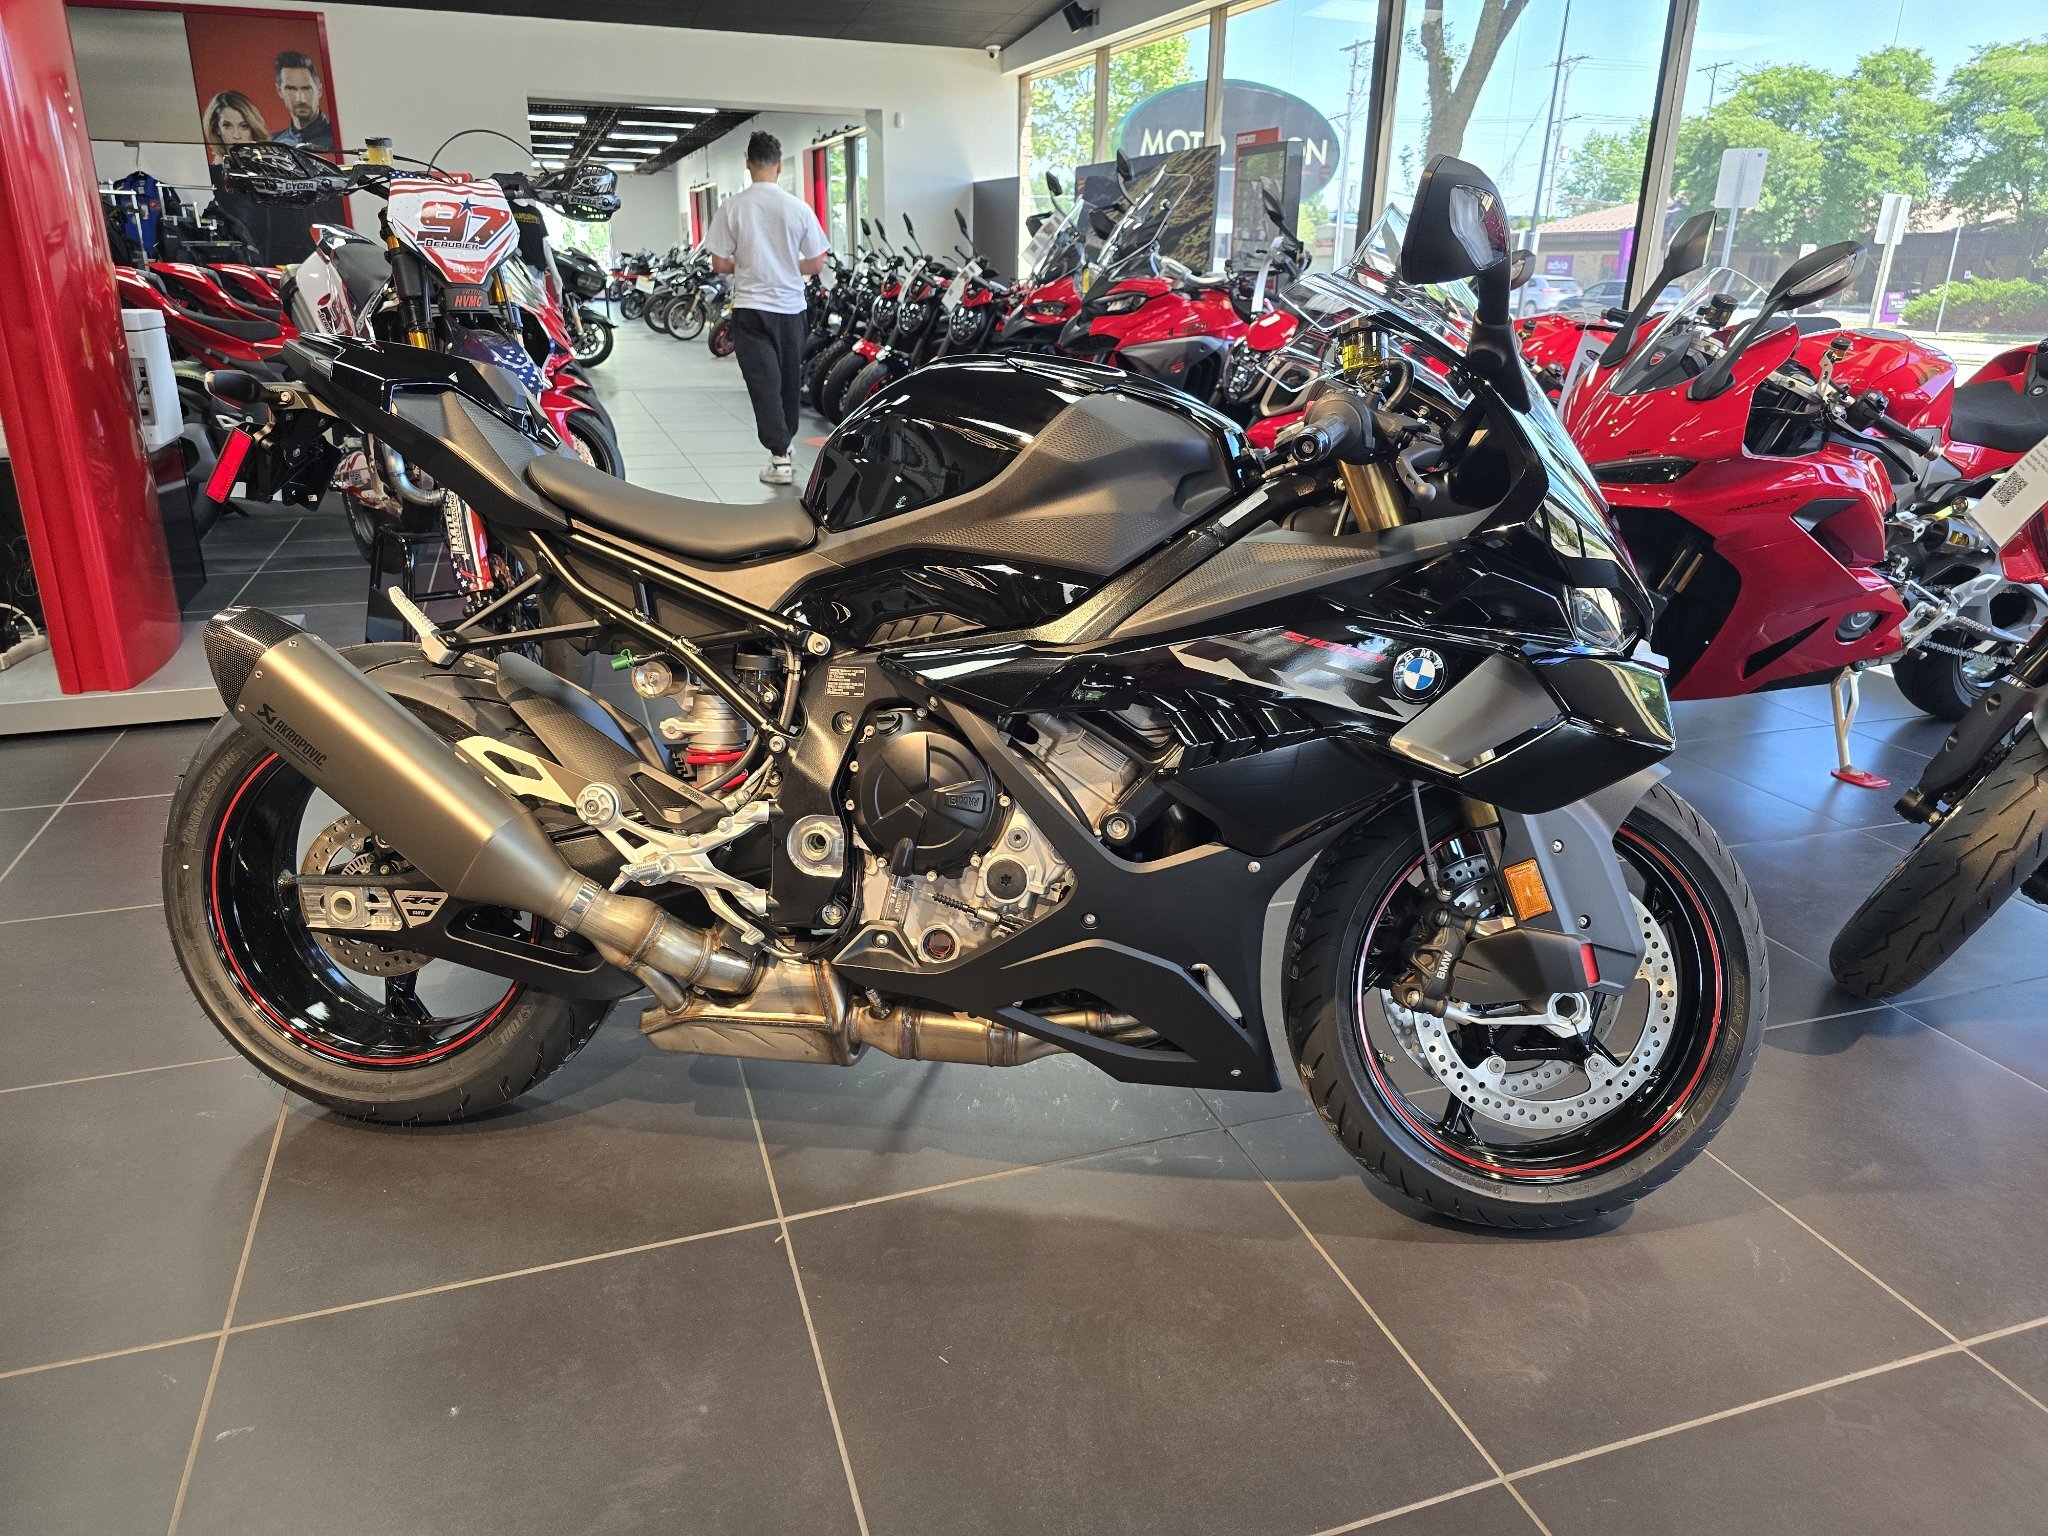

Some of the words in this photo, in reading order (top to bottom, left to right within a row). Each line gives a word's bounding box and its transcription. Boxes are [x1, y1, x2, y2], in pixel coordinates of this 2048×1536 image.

[285, 182, 314, 190] CYCRA
[416, 201, 511, 247] 97
[454, 295, 483, 308] HVMC
[1436, 950, 1453, 980] BMW
